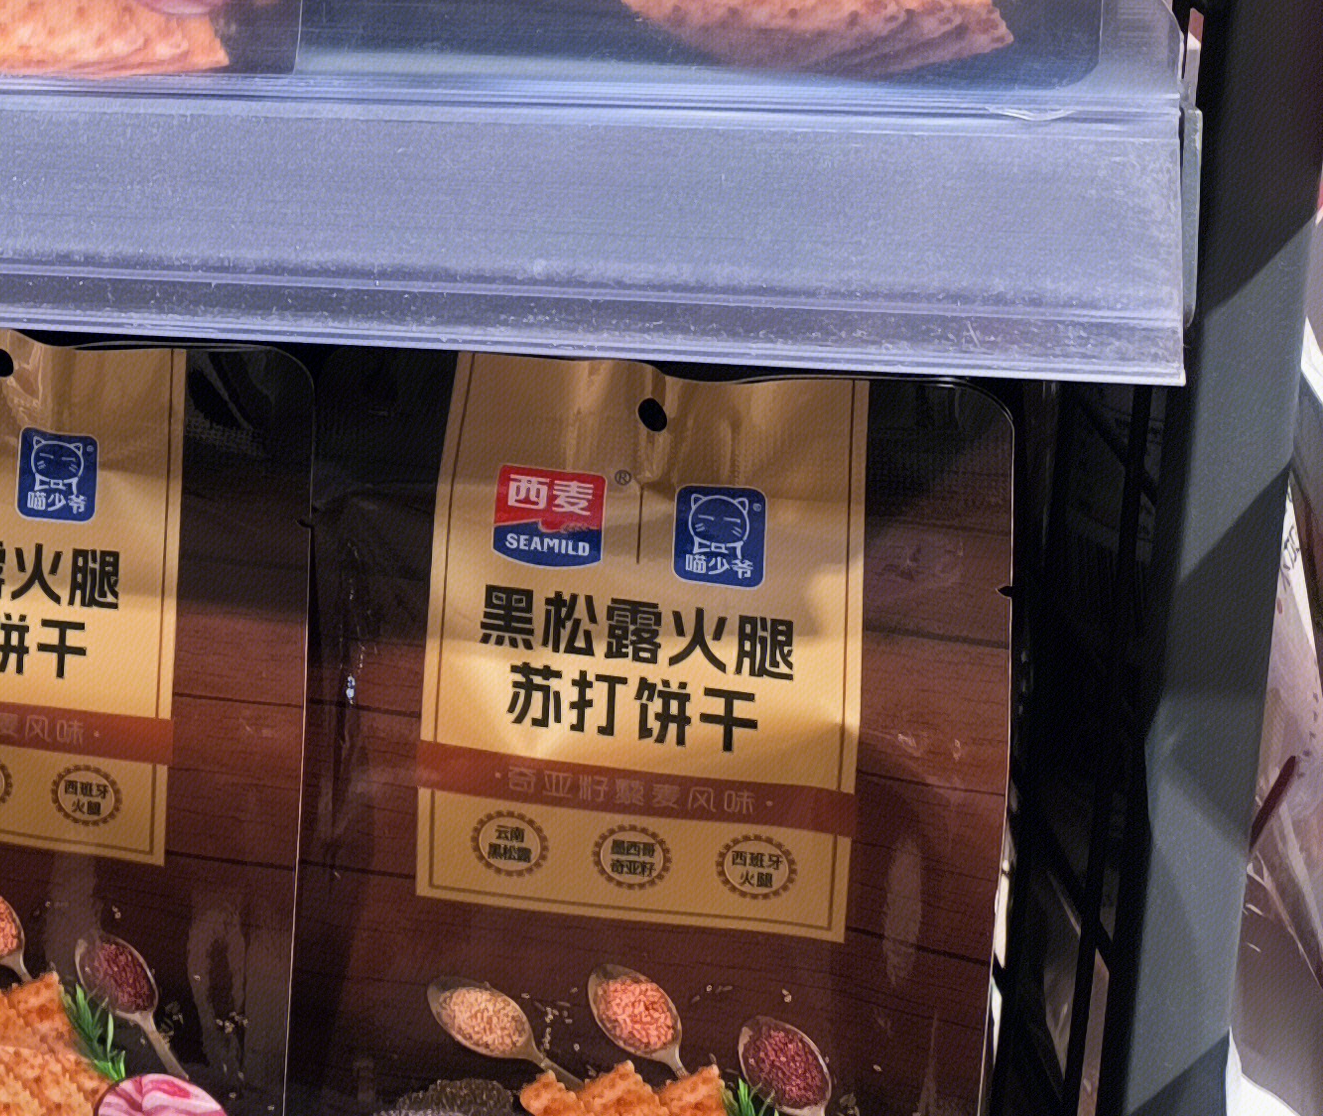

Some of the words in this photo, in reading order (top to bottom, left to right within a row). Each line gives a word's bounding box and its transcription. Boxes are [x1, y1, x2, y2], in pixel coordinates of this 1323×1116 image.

[27, 490, 87, 515] 喵少爷
[507, 473, 595, 516] 西麦
[505, 533, 590, 557] SEAMILD
[685, 554, 754, 579] 喵少爷
[479, 584, 795, 681] 黑松露火腿
[506, 661, 759, 753] 苏打饼干
[495, 825, 525, 844] 云南
[732, 850, 784, 871] 西班牙
[740, 870, 773, 889] 火腿
